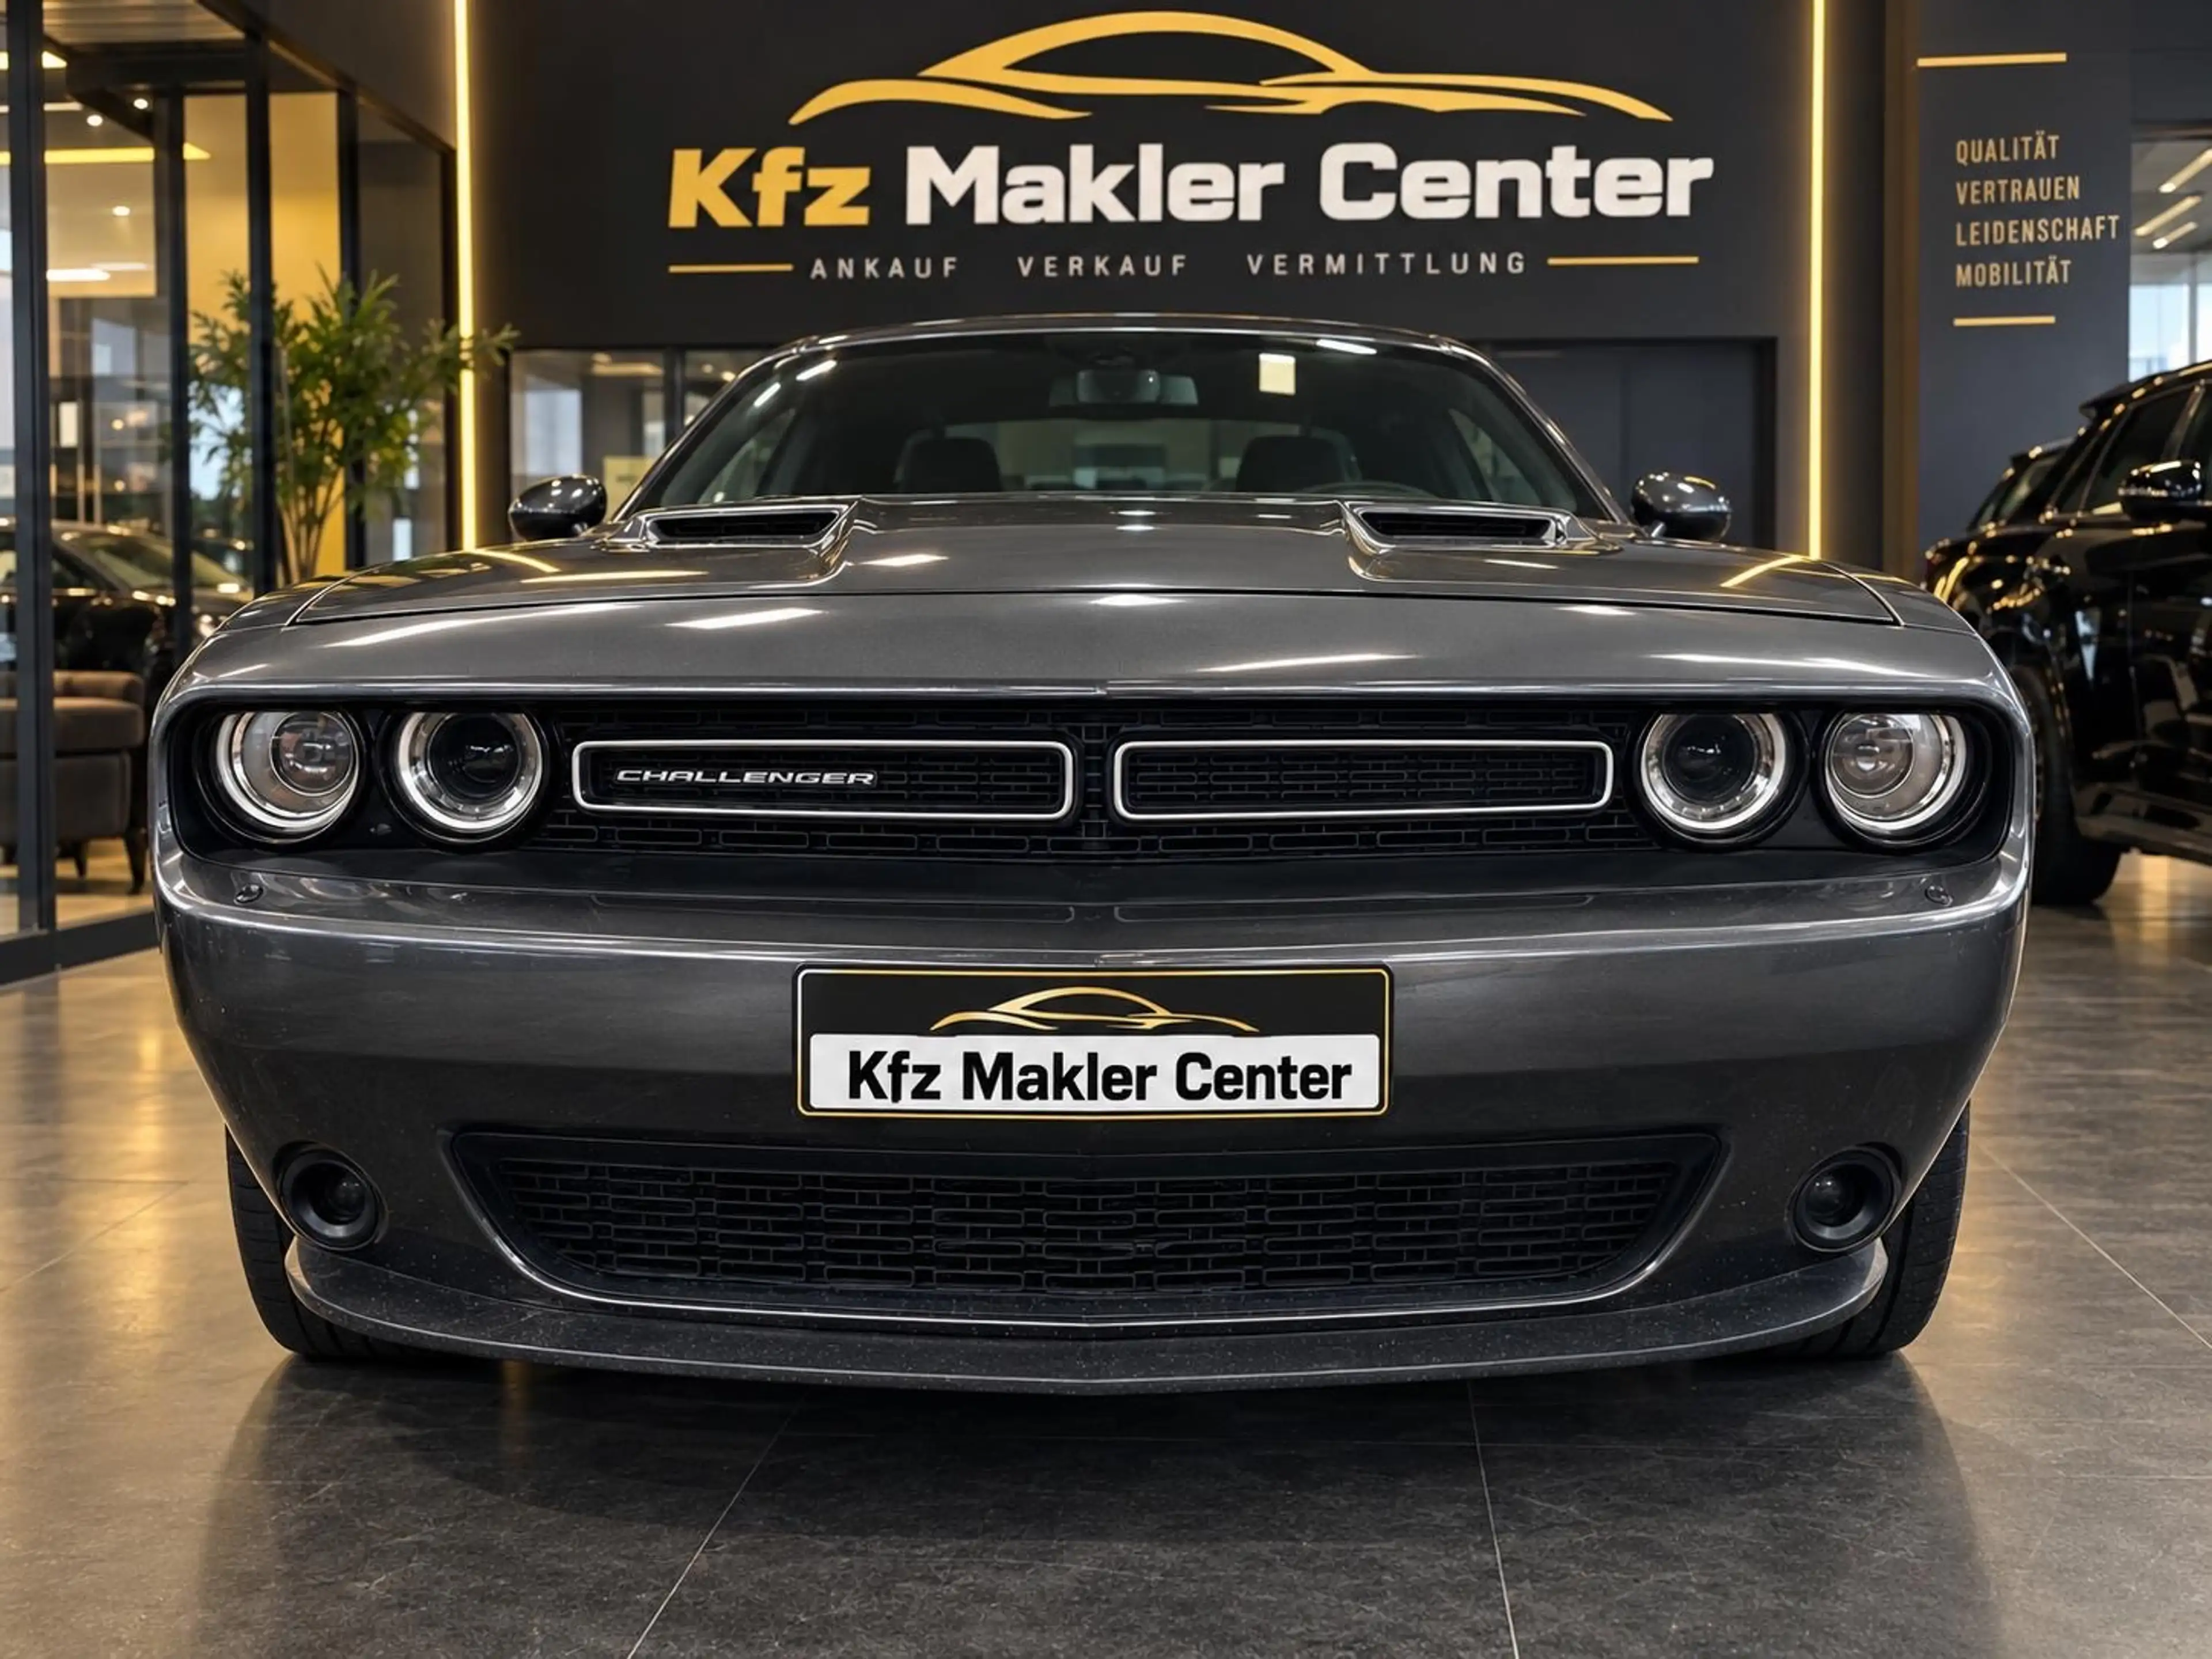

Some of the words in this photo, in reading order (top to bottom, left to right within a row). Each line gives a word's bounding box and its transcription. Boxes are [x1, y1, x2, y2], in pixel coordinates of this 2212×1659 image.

[1956, 130, 2059, 165] QUALITÄT
[669, 146, 870, 228] Kfz
[906, 143, 1285, 225] Makler
[1320, 143, 1714, 220] Center
[1956, 176, 2080, 204] VERTRAUEN
[1956, 215, 2119, 245] LEIDENSCHAFT
[810, 257, 956, 278] ANKAUF
[1018, 255, 1185, 276] VERKAUF
[1247, 252, 1524, 275] VERMITTLUNG
[1956, 255, 2071, 287] MOBILITÄT
[617, 770, 874, 785] CHALLENGER
[849, 1050, 941, 1103] Kfz
[963, 1051, 1157, 1101] Makler
[1176, 1052, 1352, 1101] Center
